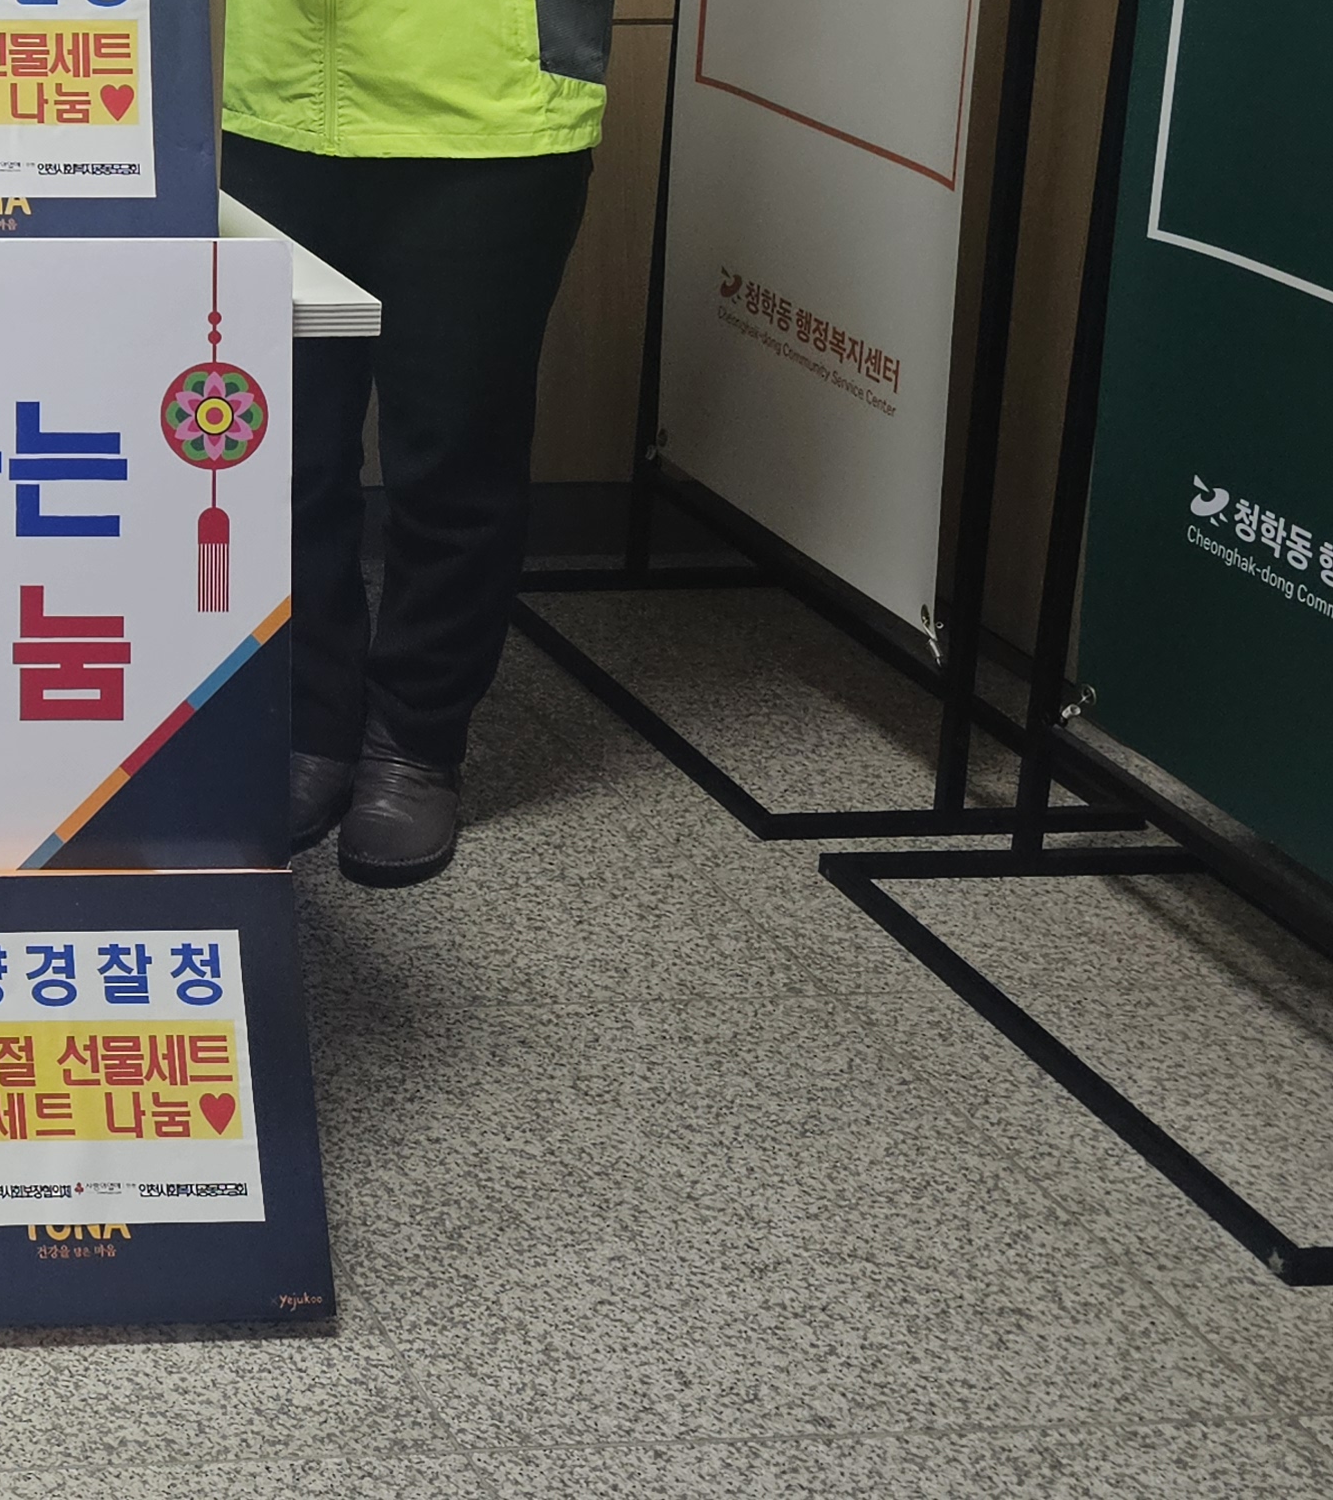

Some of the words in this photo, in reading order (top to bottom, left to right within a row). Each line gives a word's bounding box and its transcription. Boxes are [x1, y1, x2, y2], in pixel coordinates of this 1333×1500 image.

[10, 83, 91, 124] 나눔
[744, 280, 793, 332] 청학동
[795, 307, 901, 395] 행정복지센터
[1186, 524, 1295, 600] Cheonghak-dong
[1234, 498, 1314, 572] 청학동
[57, 1034, 234, 1087] 선물세트
[104, 1092, 192, 1140] 나눔
